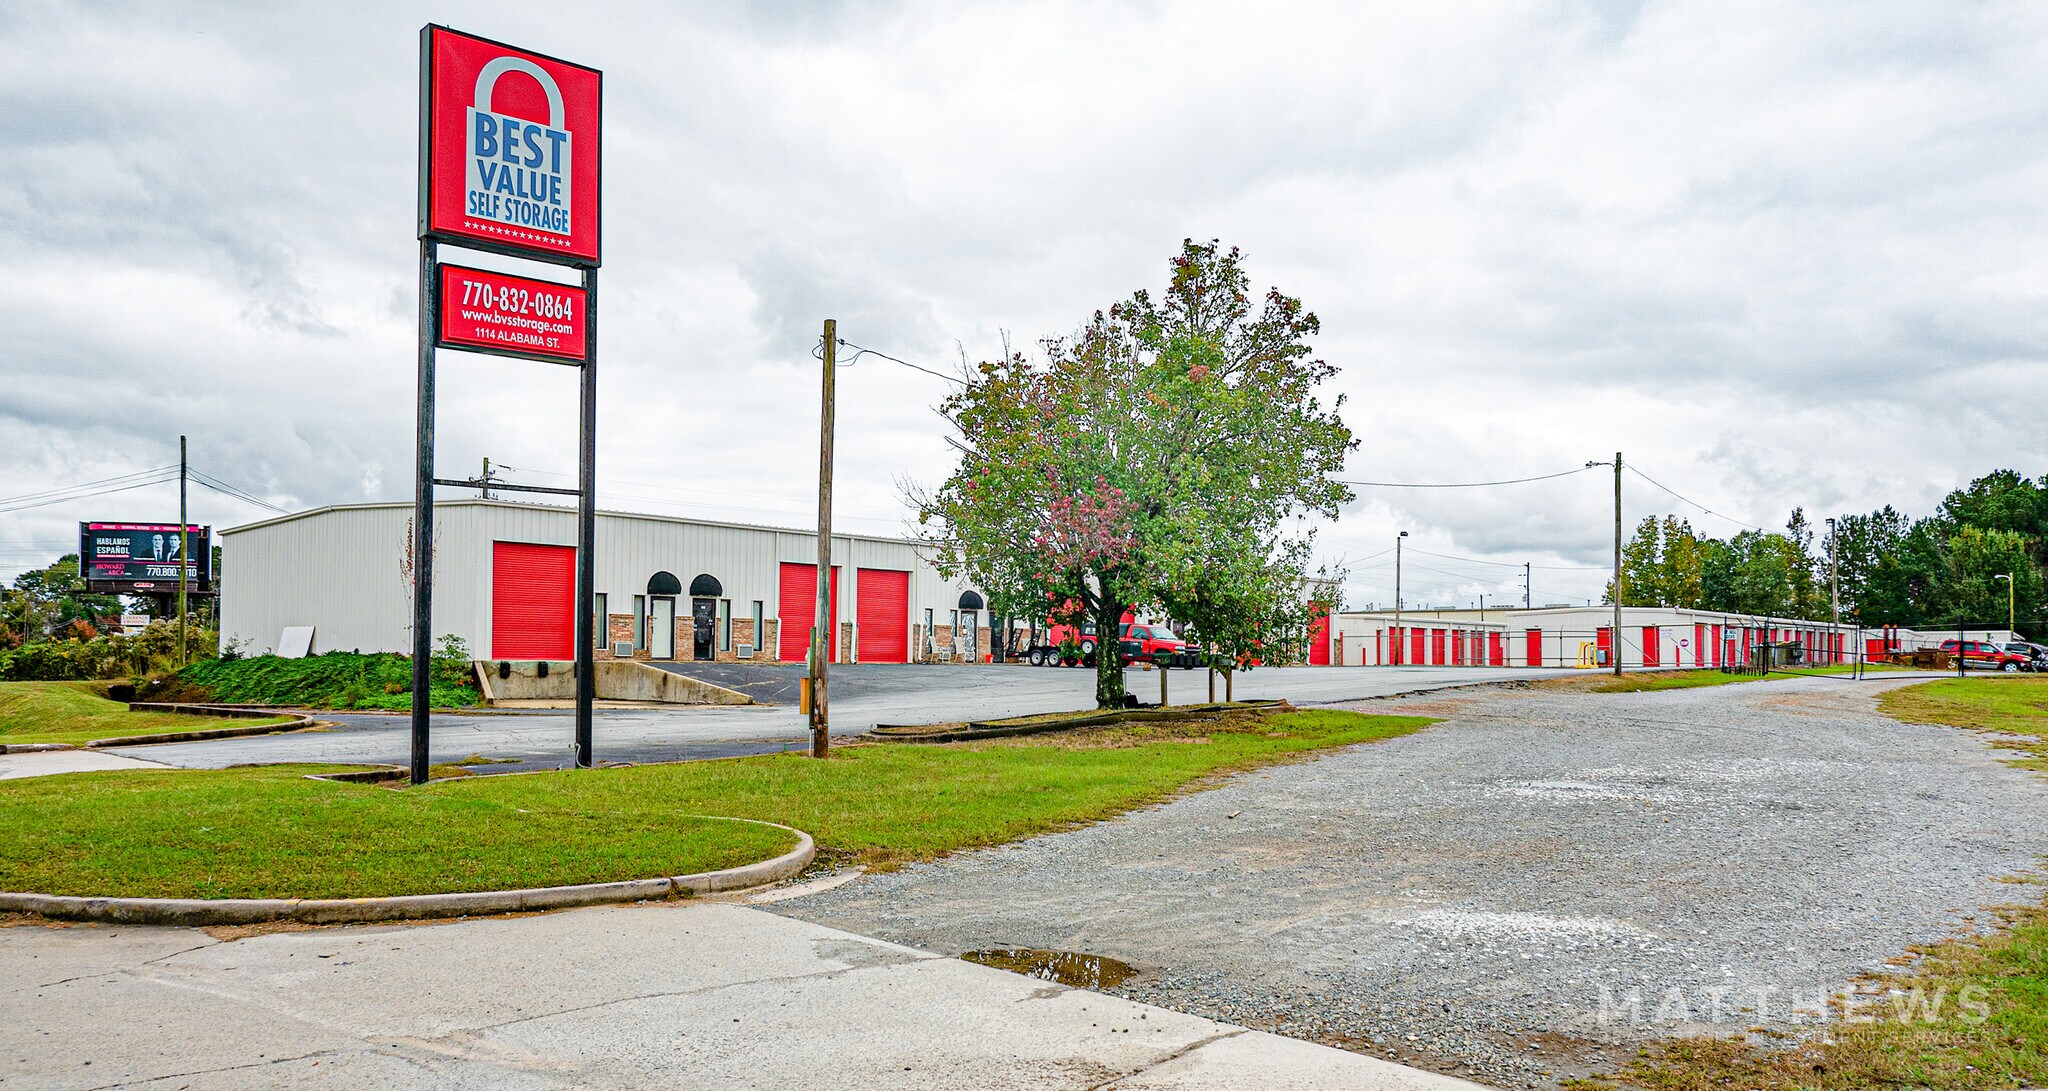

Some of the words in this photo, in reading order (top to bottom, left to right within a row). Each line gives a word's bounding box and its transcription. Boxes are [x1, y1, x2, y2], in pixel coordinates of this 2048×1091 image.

[475, 111, 567, 174] BEST
[476, 159, 562, 206] VALUE
[469, 190, 500, 219] SELF
[504, 197, 569, 233] STORAGE
[462, 280, 573, 321] 770-832-0864
[461, 309, 573, 335] www.bvsstorage.com
[475, 327, 496, 340] 1114
[497, 330, 545, 347] ALABAMA
[546, 337, 560, 349] ST.
[96, 538, 131, 546] HABLAMOS
[96, 546, 131, 555] ESPAÑOL
